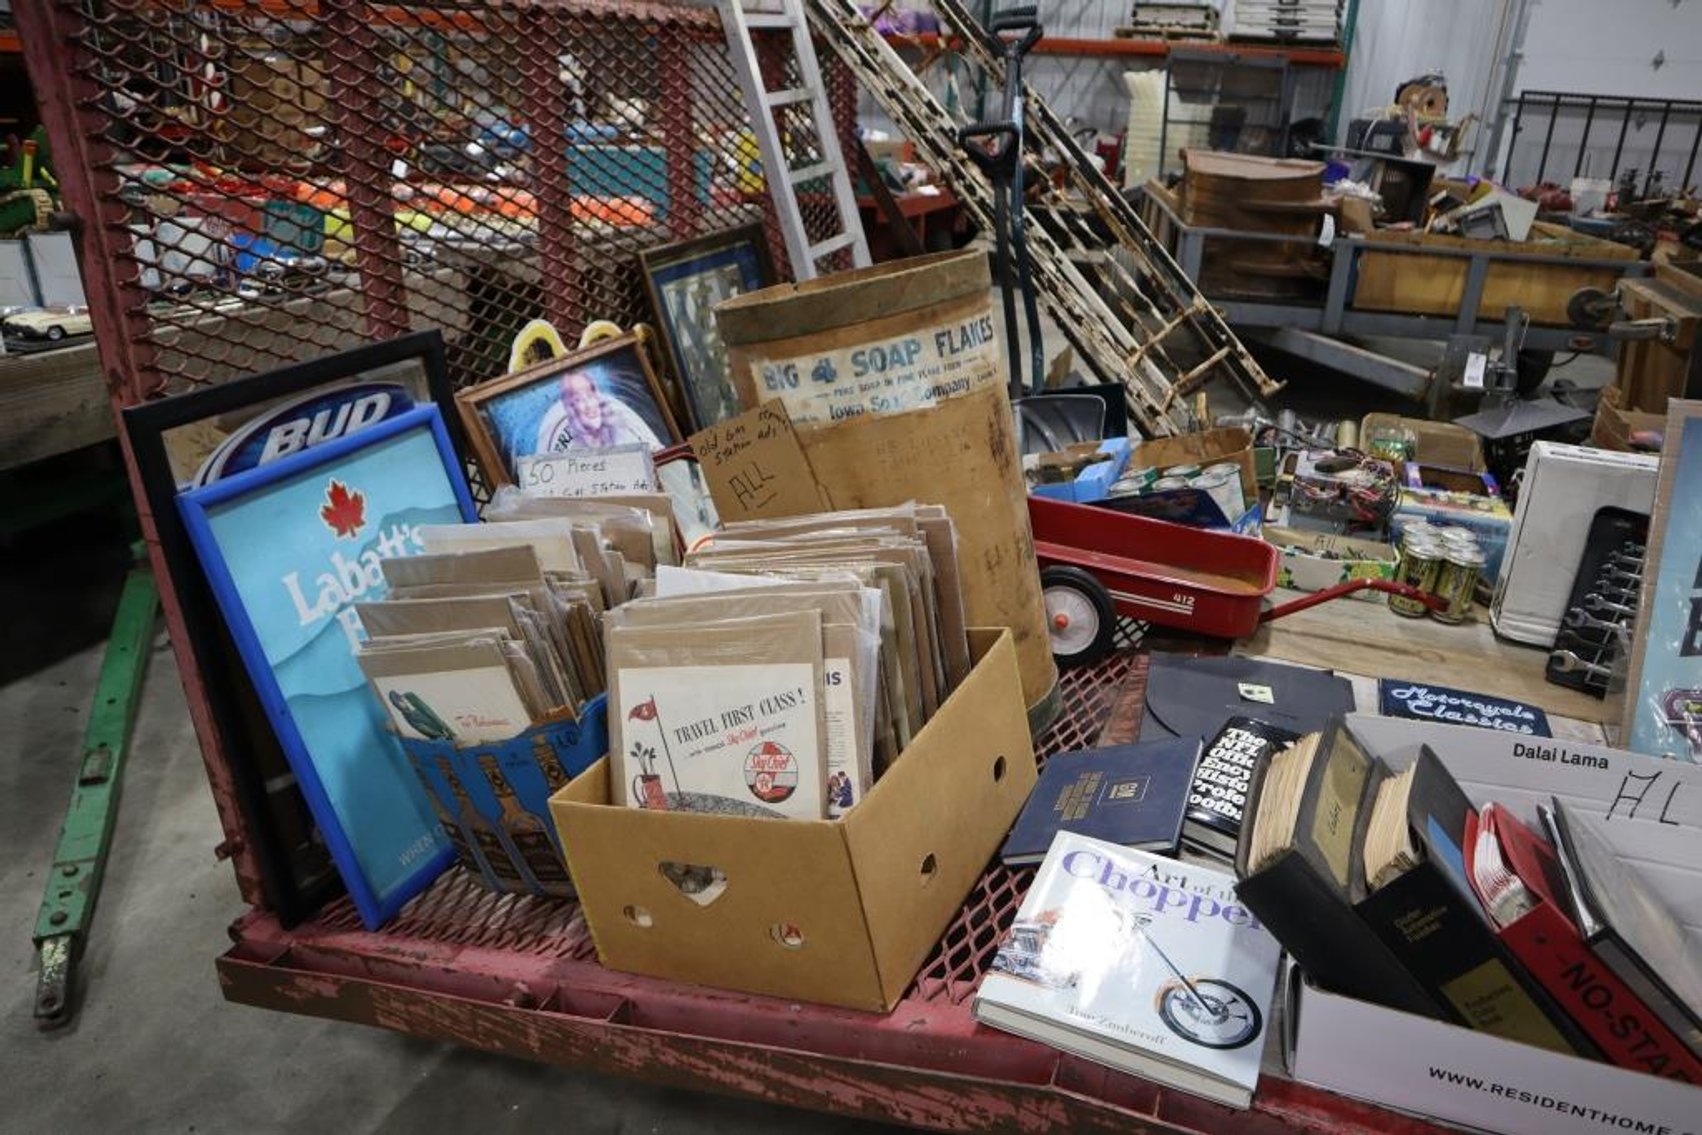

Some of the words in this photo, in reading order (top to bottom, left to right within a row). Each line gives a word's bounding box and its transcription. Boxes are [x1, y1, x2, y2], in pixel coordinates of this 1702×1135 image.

[762, 364, 800, 392] BIG
[811, 357, 838, 385] 4
[851, 338, 922, 378] SOAP
[934, 315, 994, 358] FLAKES
[829, 404, 865, 420] Iowa
[921, 376, 972, 401] ompany
[258, 392, 391, 466] BUD
[527, 461, 555, 488] 50
[567, 458, 607, 474] Pieces
[728, 461, 775, 511] ALL
[1172, 593, 1195, 606] 412
[826, 672, 842, 686] IS
[1391, 686, 1536, 719] Motorcycle
[1406, 699, 1535, 735] Classics
[673, 718, 718, 745] TRAVEL
[721, 705, 755, 731] FIRST
[1226, 727, 1268, 746] The
[1218, 737, 1262, 757] NFL
[1513, 743, 1557, 763] Dalai
[1560, 746, 1609, 770] Lama
[1141, 864, 1188, 889] Art
[1219, 887, 1241, 902] th
